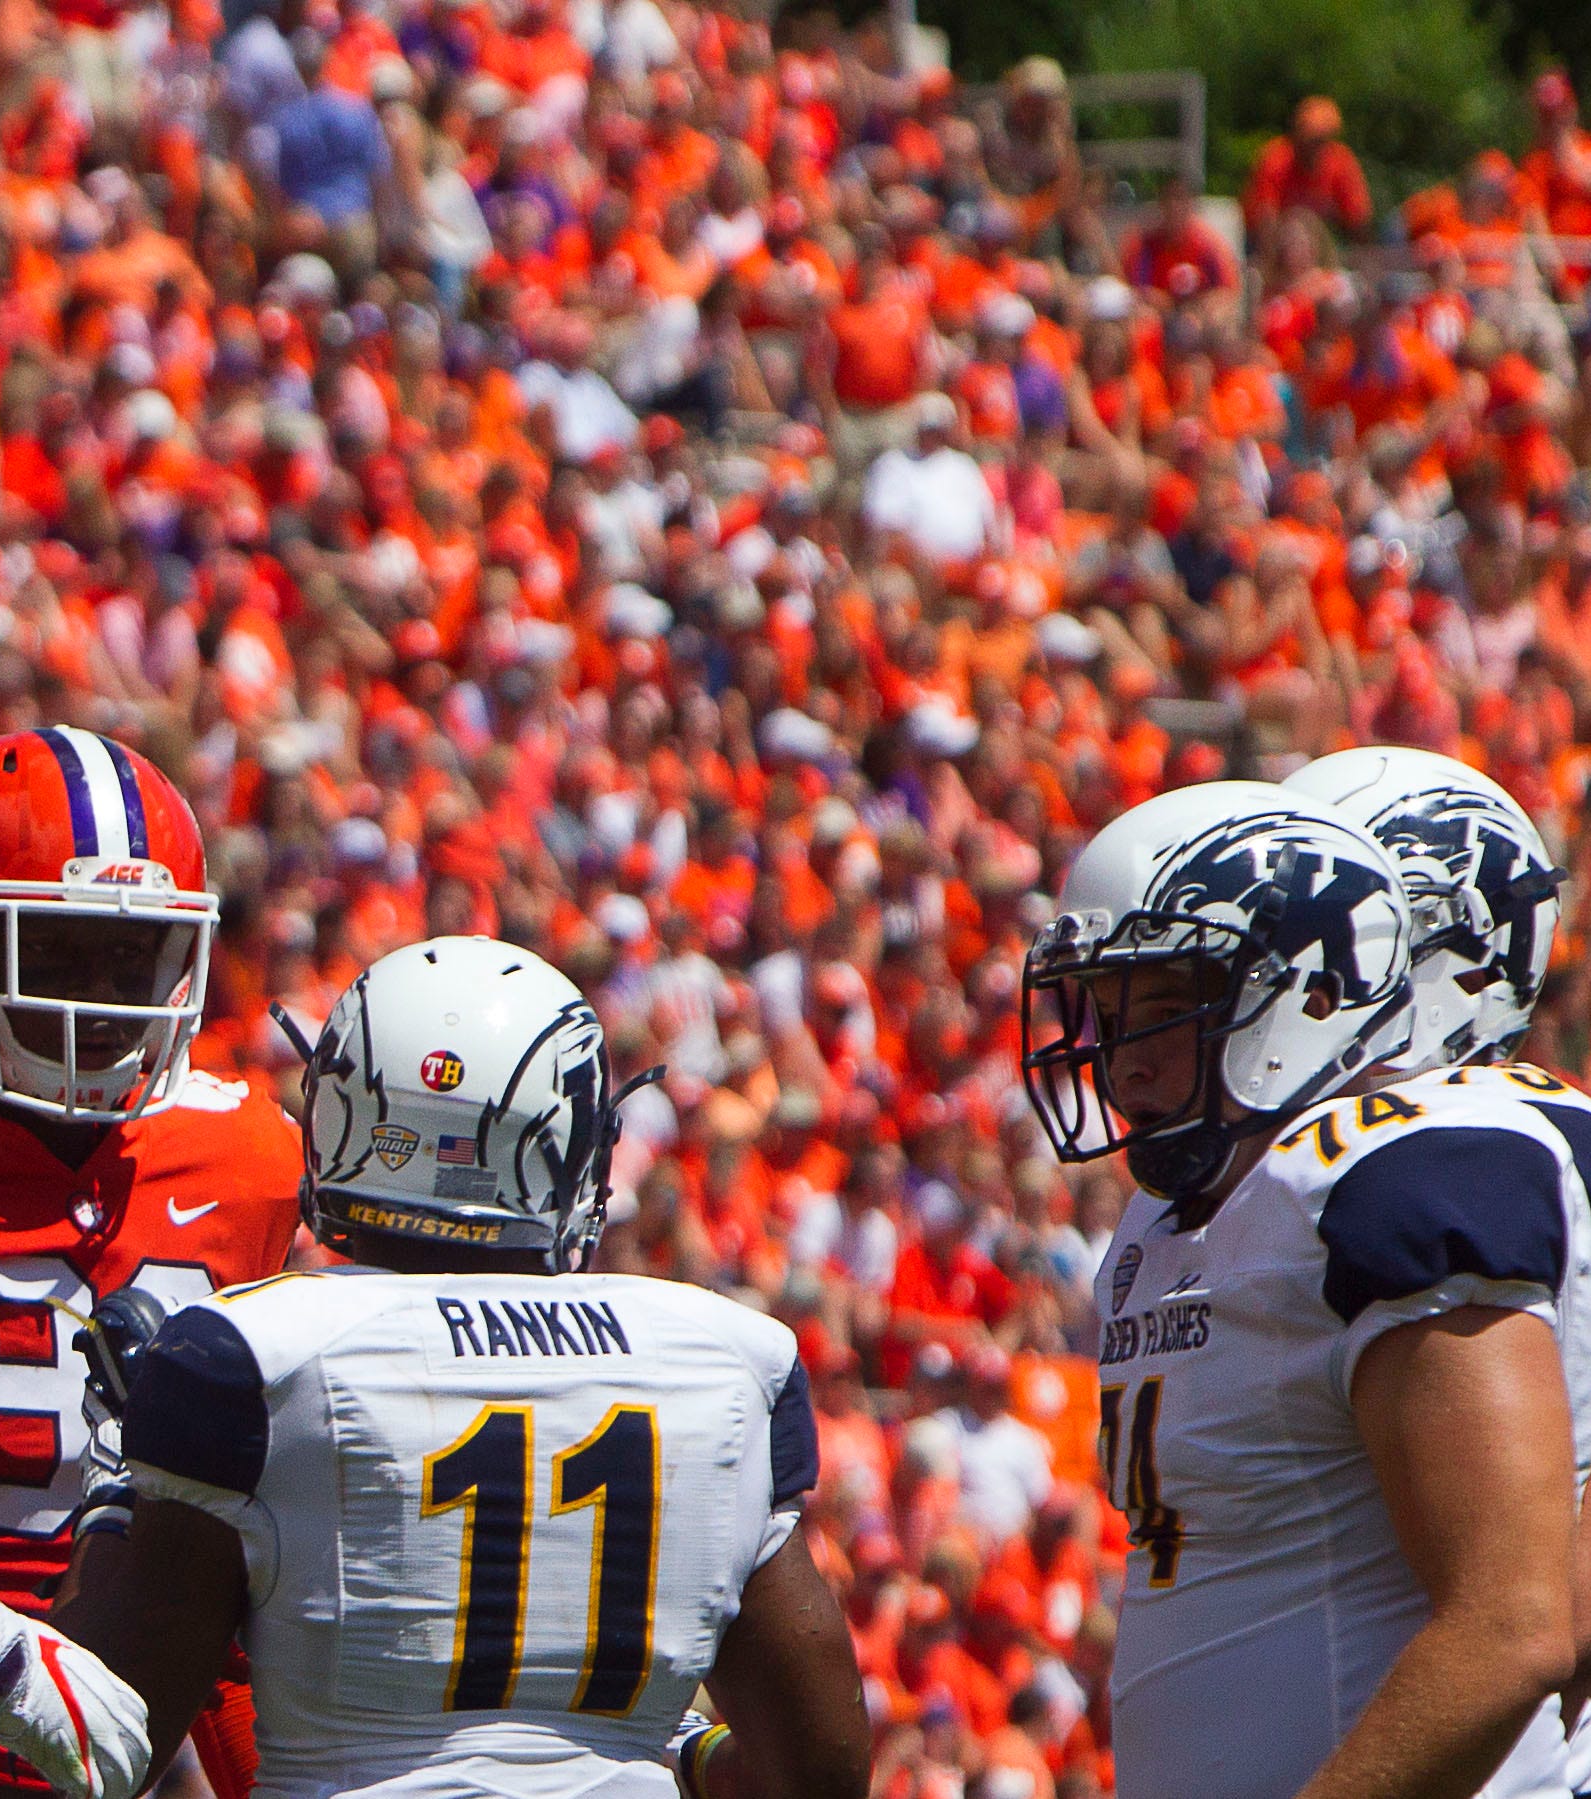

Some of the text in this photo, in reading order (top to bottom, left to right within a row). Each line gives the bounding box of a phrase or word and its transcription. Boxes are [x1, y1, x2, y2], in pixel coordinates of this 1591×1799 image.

[91, 864, 144, 885] ACC
[423, 1054, 462, 1087] TH
[1272, 1088, 1427, 1167] 74
[436, 1297, 632, 1358] RANKIN
[1143, 1302, 1212, 1358] FLASHES
[419, 1402, 662, 1719] 11
